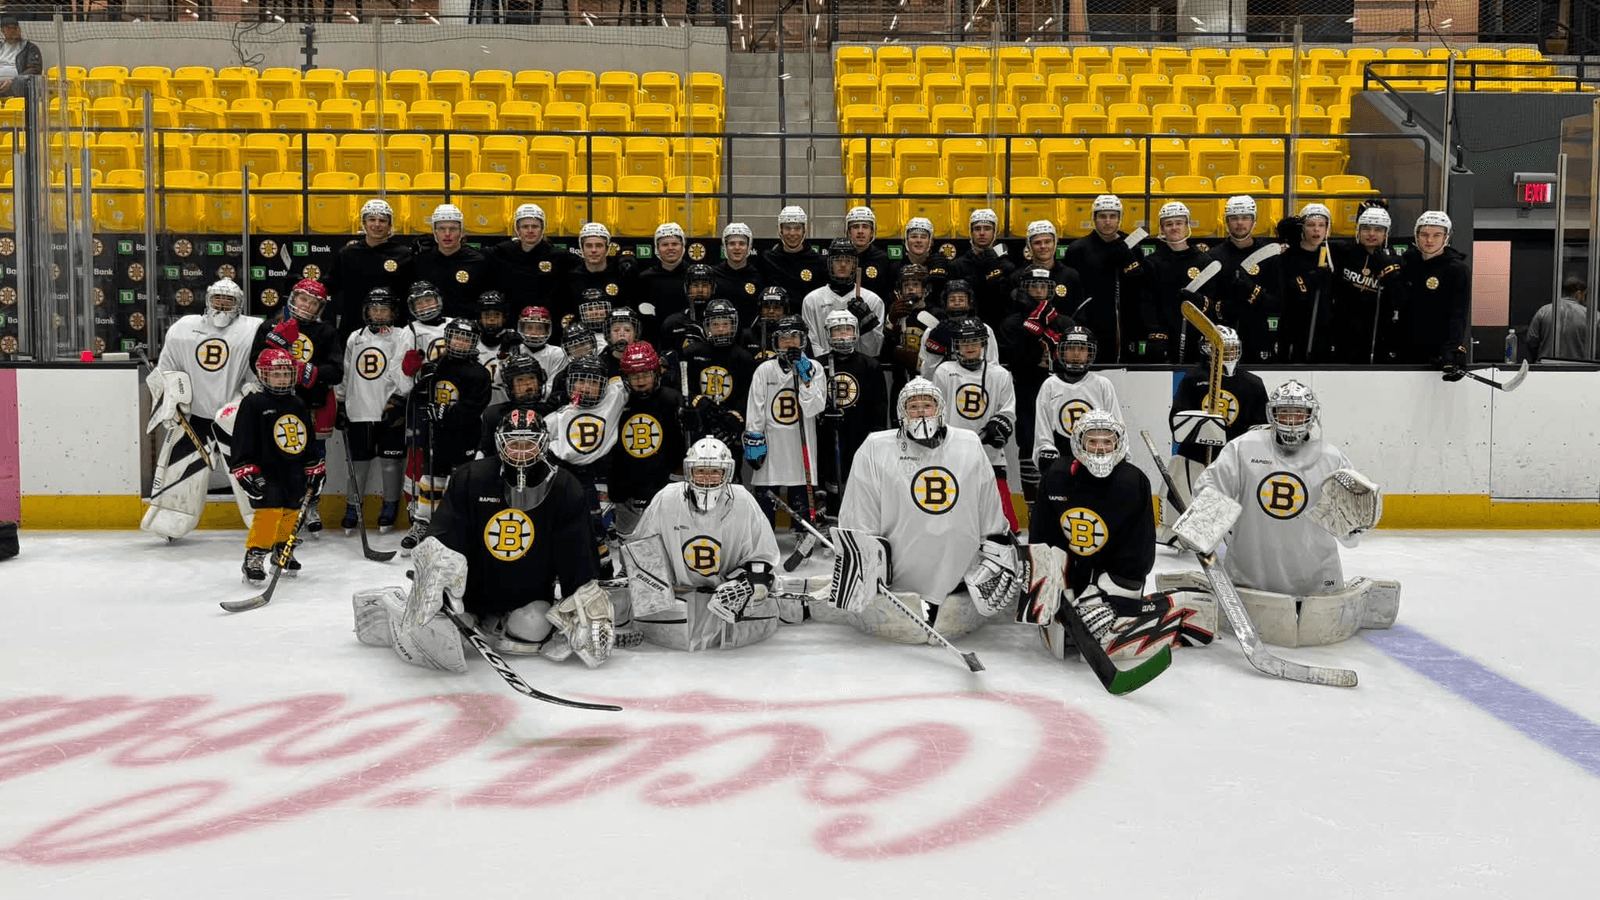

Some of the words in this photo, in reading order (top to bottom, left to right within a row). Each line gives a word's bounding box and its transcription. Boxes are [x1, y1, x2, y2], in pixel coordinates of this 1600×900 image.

[1524, 183, 1549, 202] EXIT
[311, 245, 331, 253] Bank
[94, 268, 113, 276] Bank
[268, 269, 288, 277] Bank
[1343, 267, 1384, 290] BRUIN
[95, 317, 115, 325] Bank
[204, 345, 222, 364] B
[364, 354, 379, 374] B
[836, 381, 849, 399] B
[963, 390, 980, 412] B
[778, 396, 796, 418] B
[283, 423, 299, 447] B
[578, 422, 599, 448] B
[631, 423, 652, 450] B
[1200, 438, 1223, 446] CCM
[924, 476, 947, 504] B
[1270, 481, 1295, 510] B
[496, 520, 522, 551] B
[1070, 518, 1095, 548] B
[279, 534, 295, 566] CCM
[693, 545, 715, 570] B
[636, 573, 665, 592] BAUER
[829, 554, 843, 602] VAUGHN
